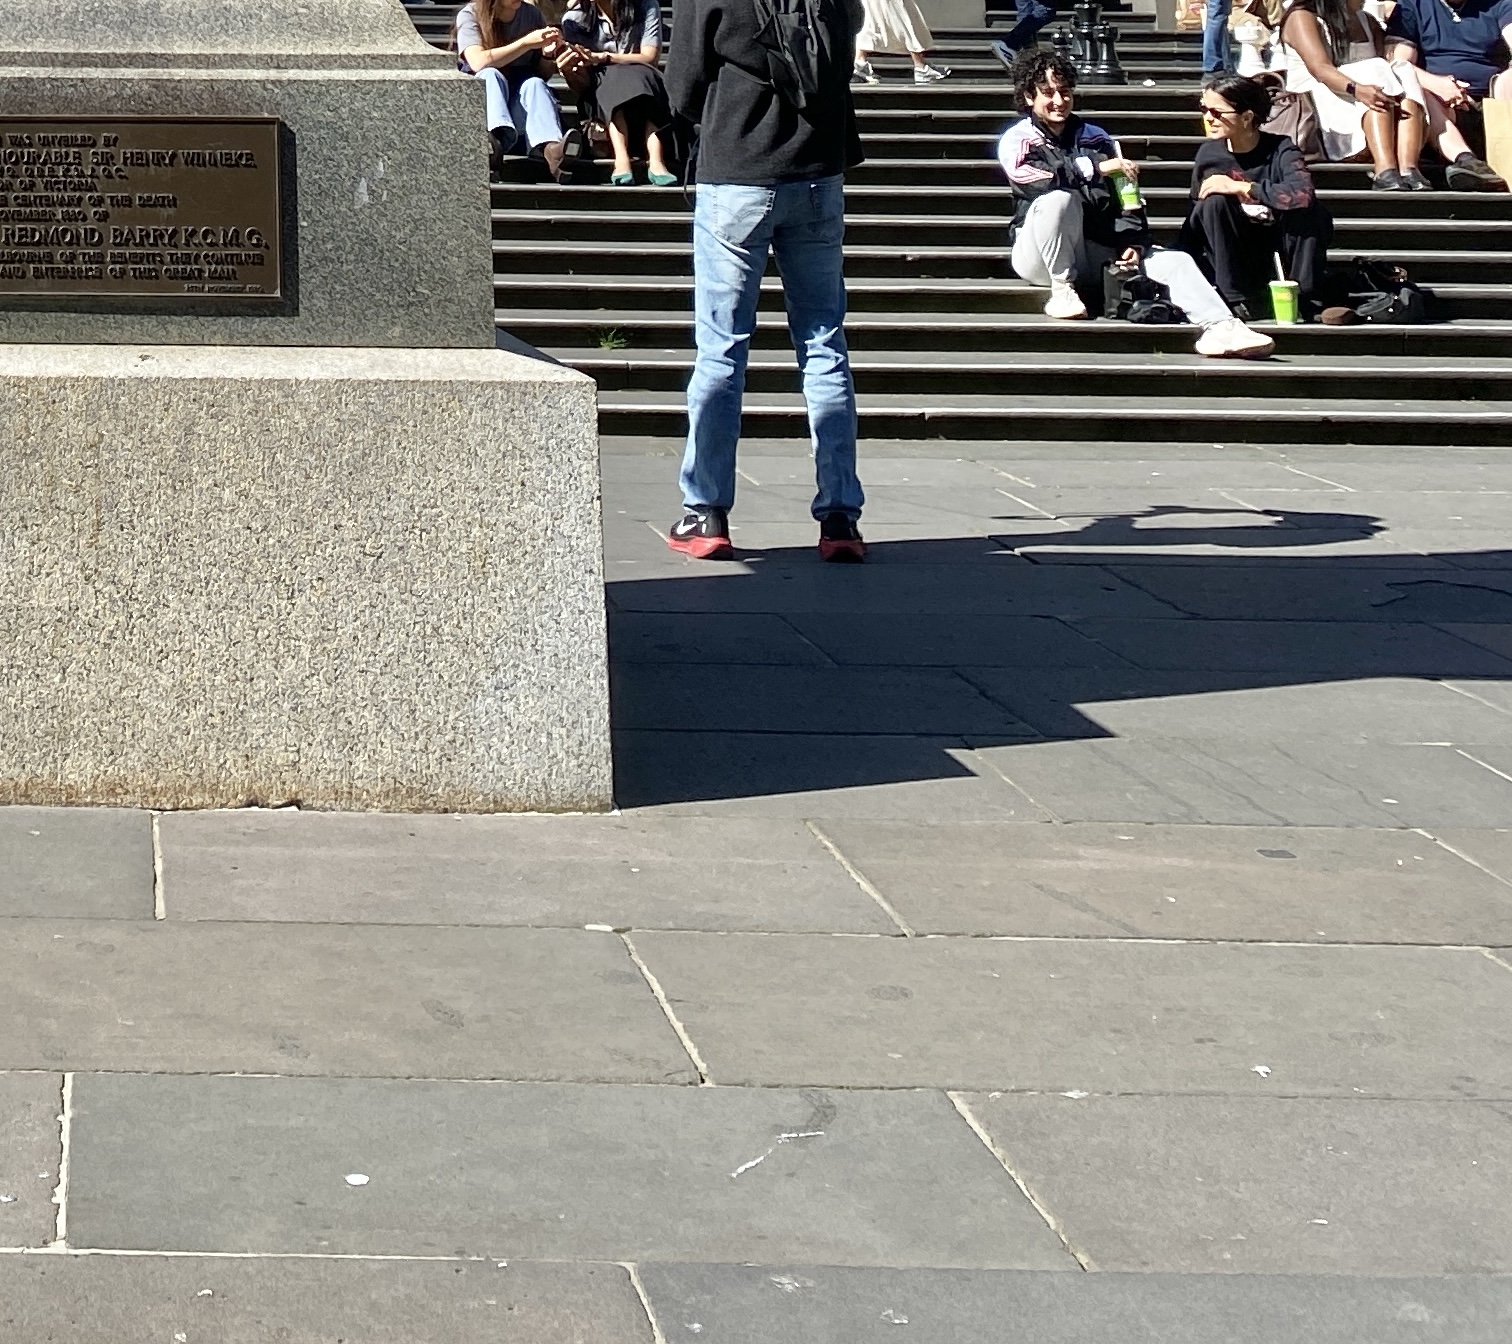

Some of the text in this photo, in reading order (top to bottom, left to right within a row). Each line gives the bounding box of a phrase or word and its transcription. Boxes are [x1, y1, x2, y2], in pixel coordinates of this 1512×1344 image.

[6, 133, 32, 147] WAS
[35, 134, 97, 147] UNVEILED
[102, 133, 119, 147] BY
[90, 150, 116, 166] SIR
[120, 150, 178, 167] HENRY
[17, 178, 37, 191] OF
[40, 179, 99, 193] VICTORIA
[11, 192, 84, 208] CENTENARY
[86, 193, 105, 208] OF
[106, 193, 133, 208] THE
[136, 193, 178, 208] DEATH
[91, 208, 110, 223] OF
[1, 225, 104, 247] REDMOND
[57, 250, 77, 264] OF
[78, 250, 105, 264] THE
[201, 251, 266, 266] CONTINUE
[29, 265, 104, 280] ENTERPRISE
[107, 265, 128, 280] OF
[129, 265, 160, 280] THIS
[161, 265, 204, 281] GREAT
